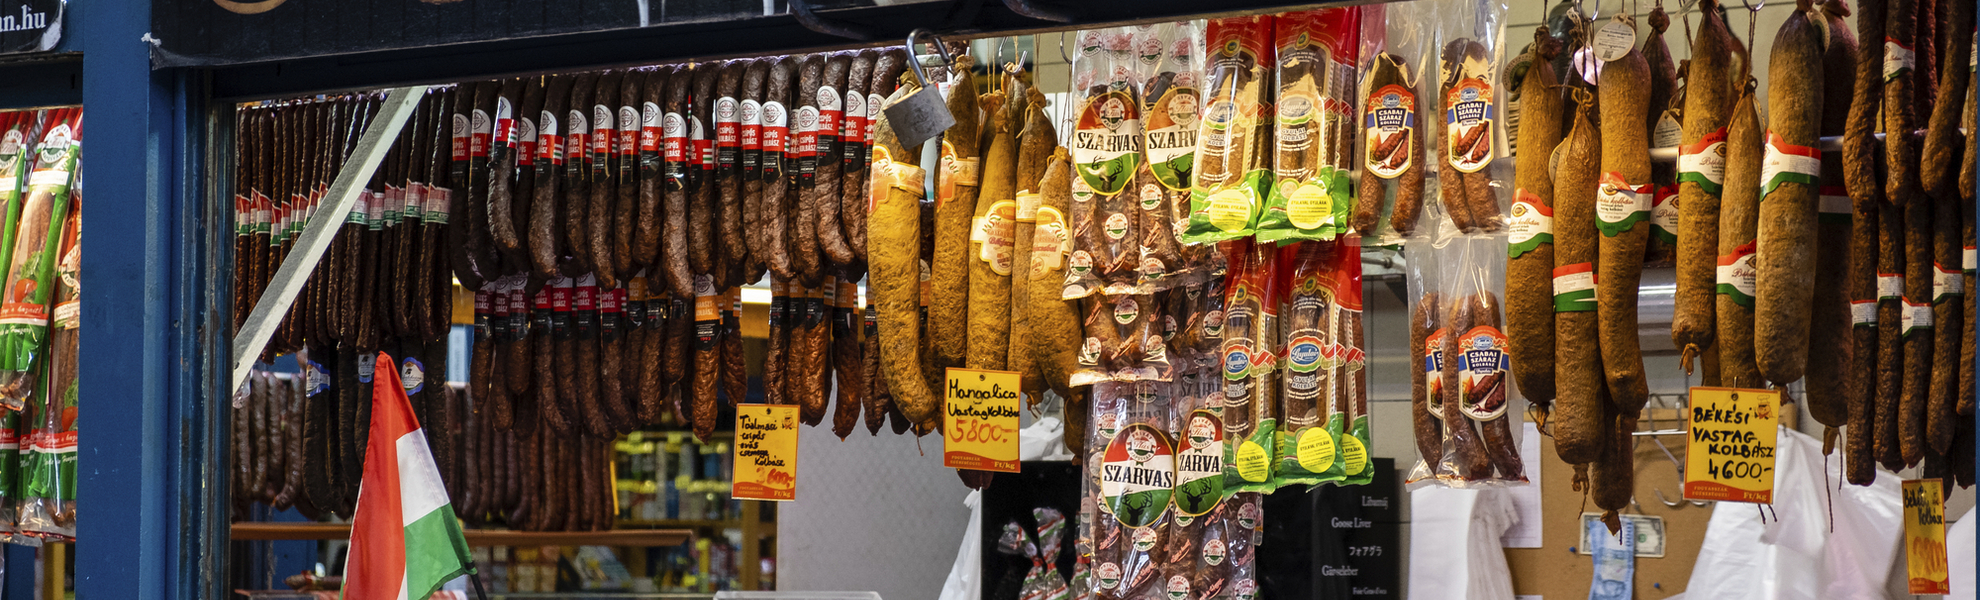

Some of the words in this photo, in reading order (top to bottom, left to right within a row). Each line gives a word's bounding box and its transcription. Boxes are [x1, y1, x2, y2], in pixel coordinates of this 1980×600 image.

[1457, 102, 1483, 111] CSABAI
[1458, 108, 1482, 116] SZÁRAZ
[1077, 132, 1139, 152] SZARVAS
[949, 378, 1019, 405] Mangalica
[1693, 402, 1752, 425] BÉKÉSI
[1692, 426, 1758, 444] VASTAG
[1708, 440, 1774, 459] KOLBÁSZ
[994, 461, 1016, 470] Ft/kg
[1179, 453, 1223, 473] ZARVA
[1104, 464, 1173, 489] SZARVAS
[1743, 491, 1768, 502] Ft/kg
[1331, 517, 1353, 528] Goose
[1354, 517, 1372, 528] Liver
[1349, 545, 1382, 557] フォアグラ
